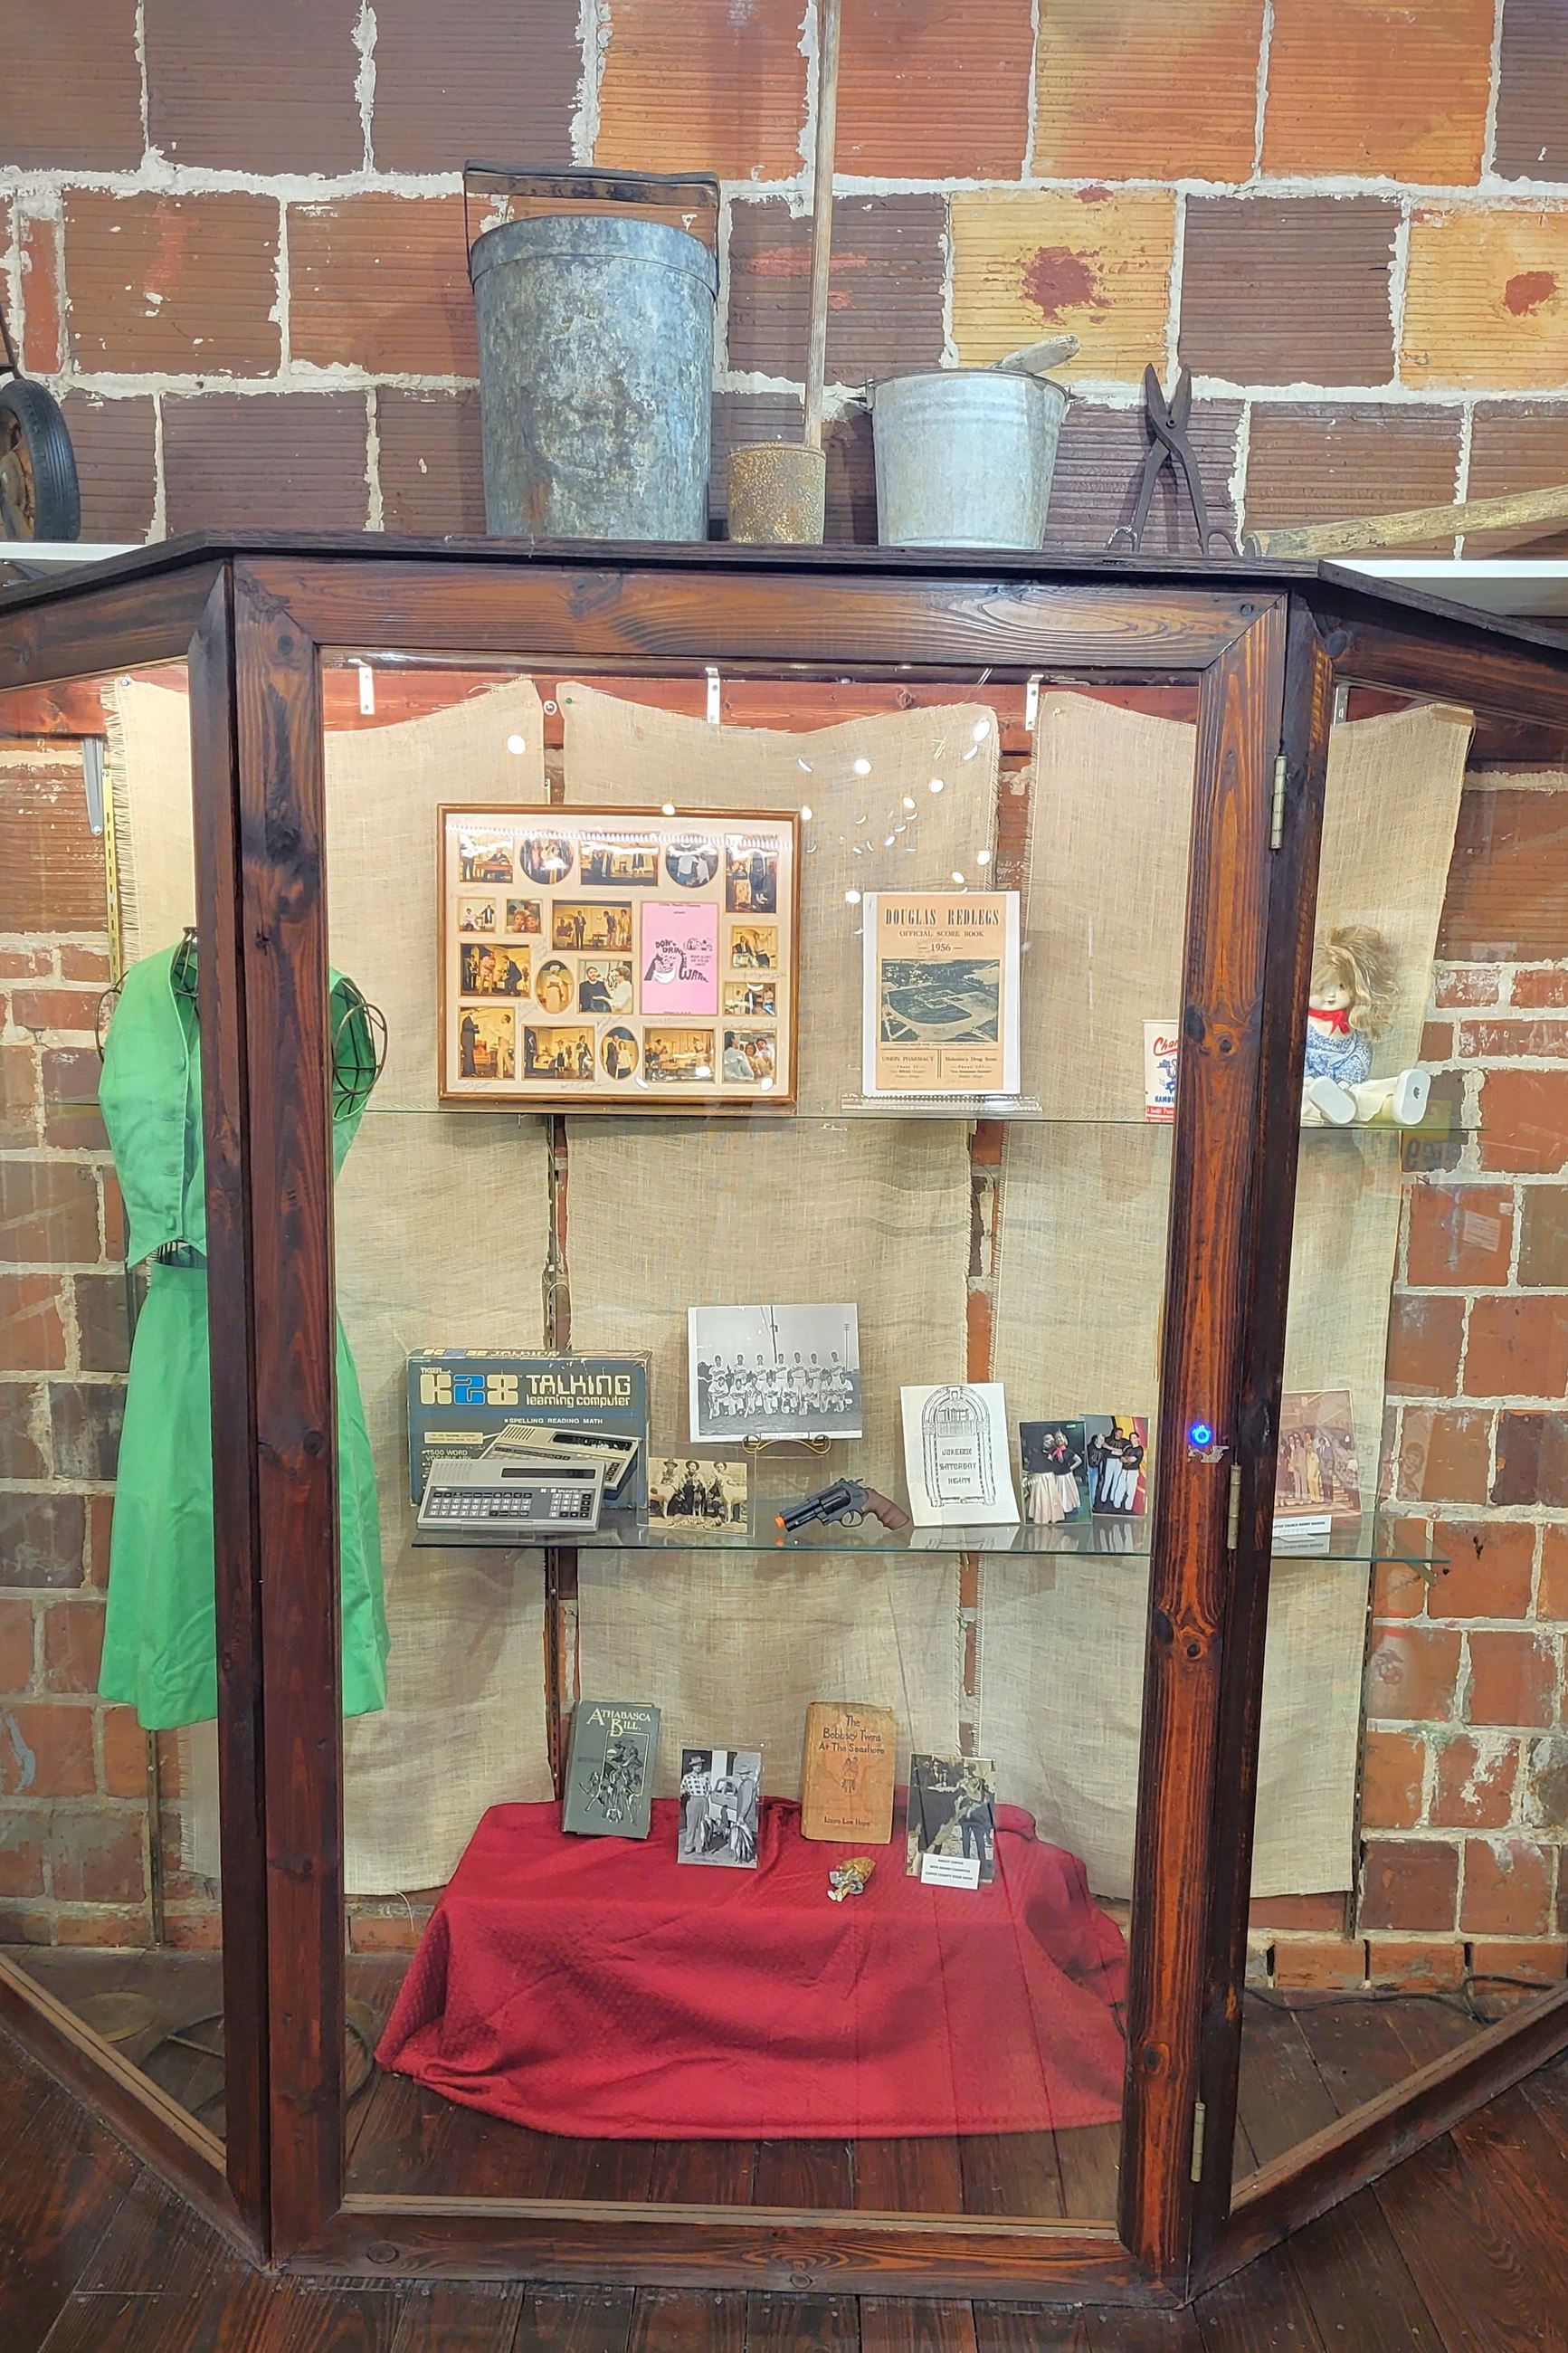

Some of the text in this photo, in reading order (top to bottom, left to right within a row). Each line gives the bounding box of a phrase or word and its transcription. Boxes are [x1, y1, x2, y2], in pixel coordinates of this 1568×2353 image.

[886, 909, 999, 926] DOUGLAS REDLEGS
[931, 943, 951, 952] 1956
[420, 1374, 519, 1405] K28
[526, 1374, 631, 1396] TALKING
[526, 1394, 631, 1408] learning computer
[586, 1708, 651, 1726] ATHABASCA
[846, 1715, 860, 1728] The
[823, 1728, 881, 1742] Bobbsey Twins
[818, 1742, 885, 1755] At The Seashore
